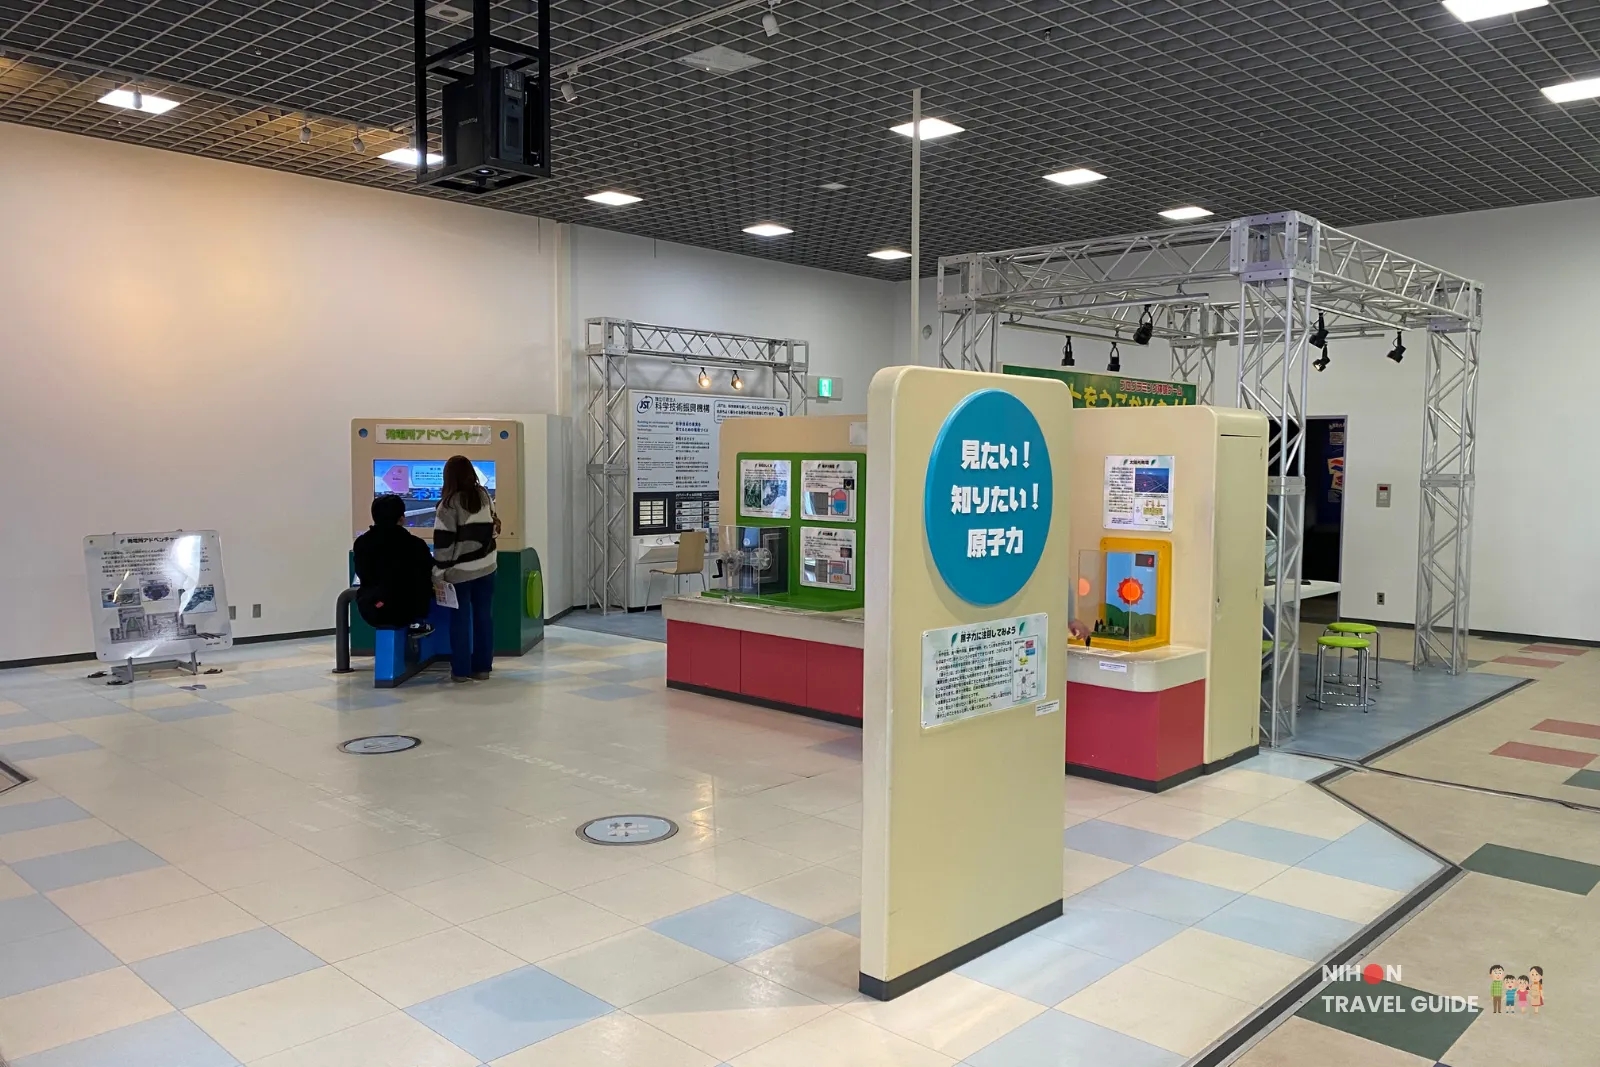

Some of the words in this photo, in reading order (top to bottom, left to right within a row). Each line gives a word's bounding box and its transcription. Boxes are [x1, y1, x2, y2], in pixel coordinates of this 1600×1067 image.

[639, 400, 651, 409] JST
[655, 402, 710, 413] 科学技術振興機構
[385, 428, 483, 441] 発電所アドベンチャー
[966, 526, 1025, 559] 原子力
[960, 626, 1017, 643] 原子力に注目してみよう
